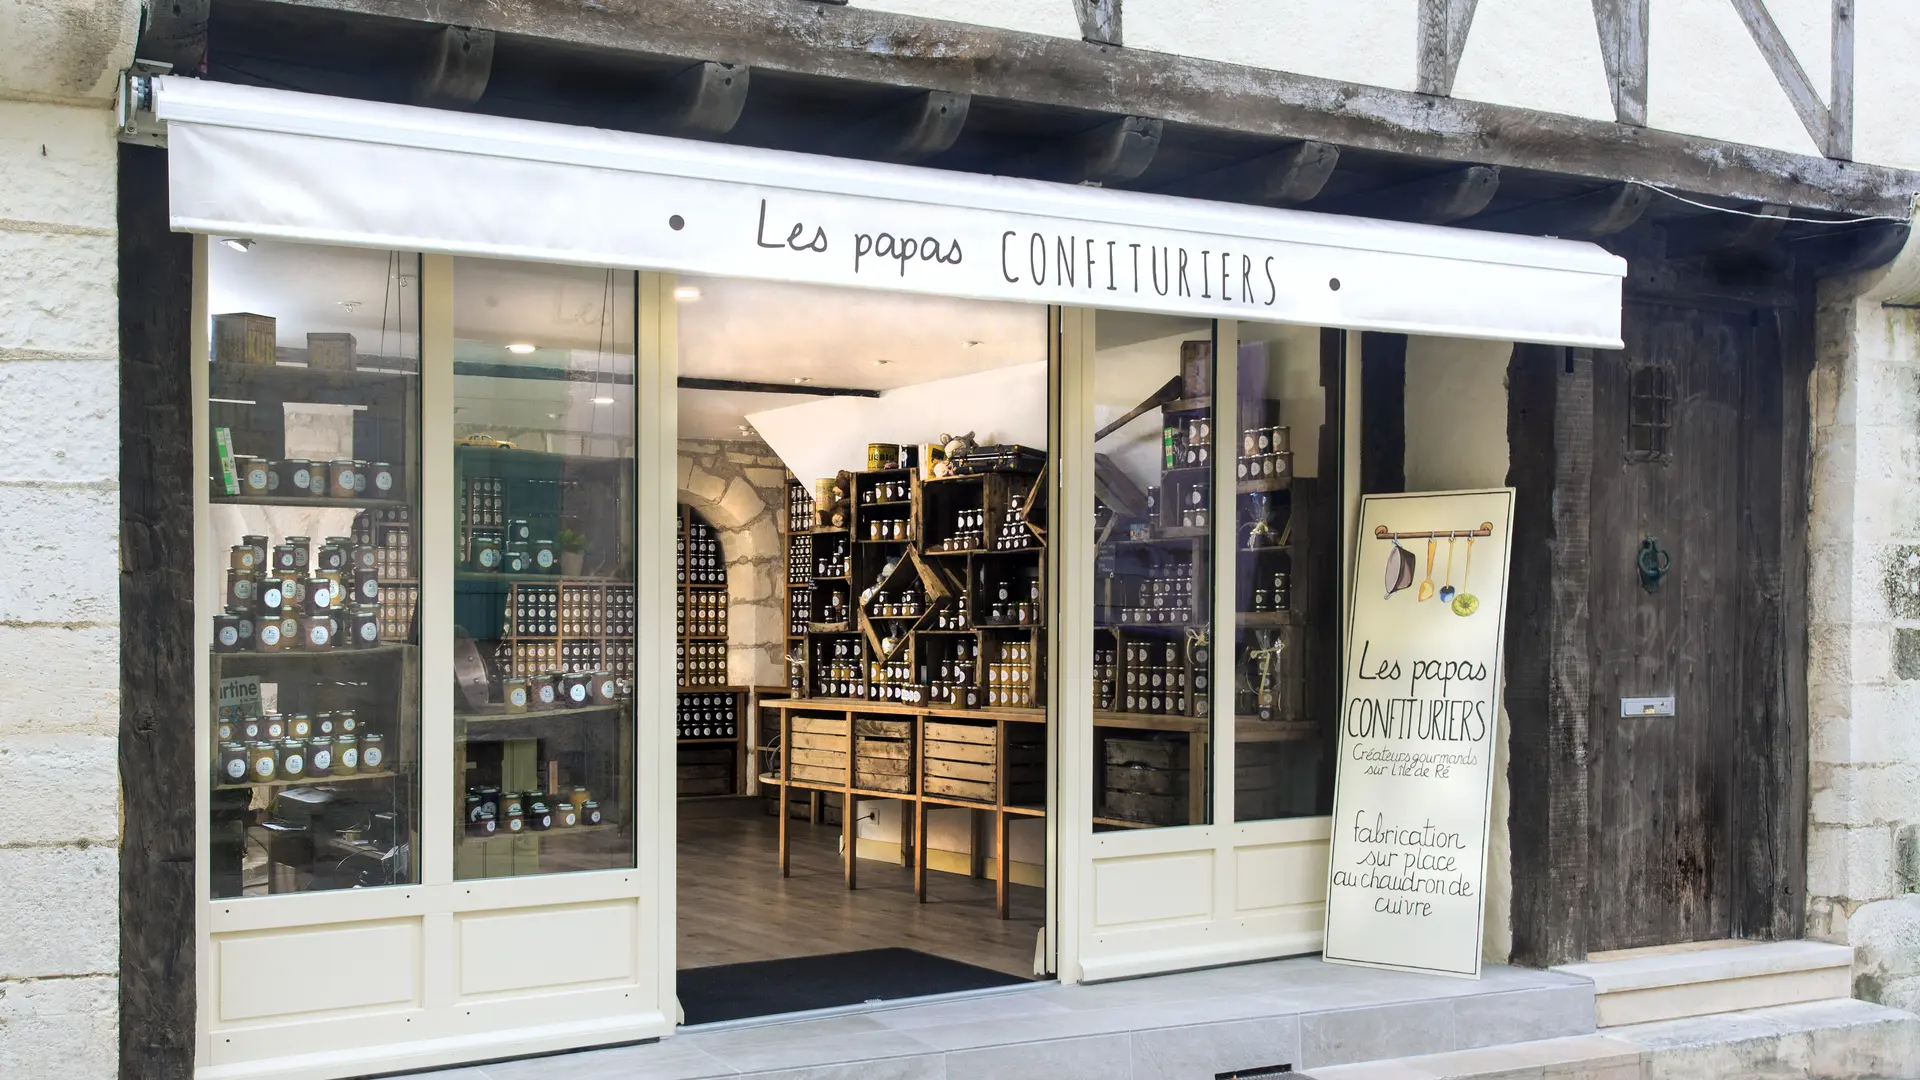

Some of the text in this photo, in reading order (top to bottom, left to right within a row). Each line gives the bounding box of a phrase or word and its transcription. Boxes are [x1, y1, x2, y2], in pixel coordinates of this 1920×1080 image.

[756, 198, 1277, 306] Les papas CONFITURIERS
[1359, 640, 1486, 697] Les papas
[1347, 697, 1486, 741] CONFITURIERS
[1352, 743, 1478, 768] Créateurs gourmands
[1364, 764, 1388, 776] sur
[1414, 763, 1429, 778] de
[1435, 764, 1451, 779] Ré
[1356, 848, 1457, 876] sur place
[1333, 868, 1474, 896] au chaudron de
[1375, 896, 1432, 917] cuivre
